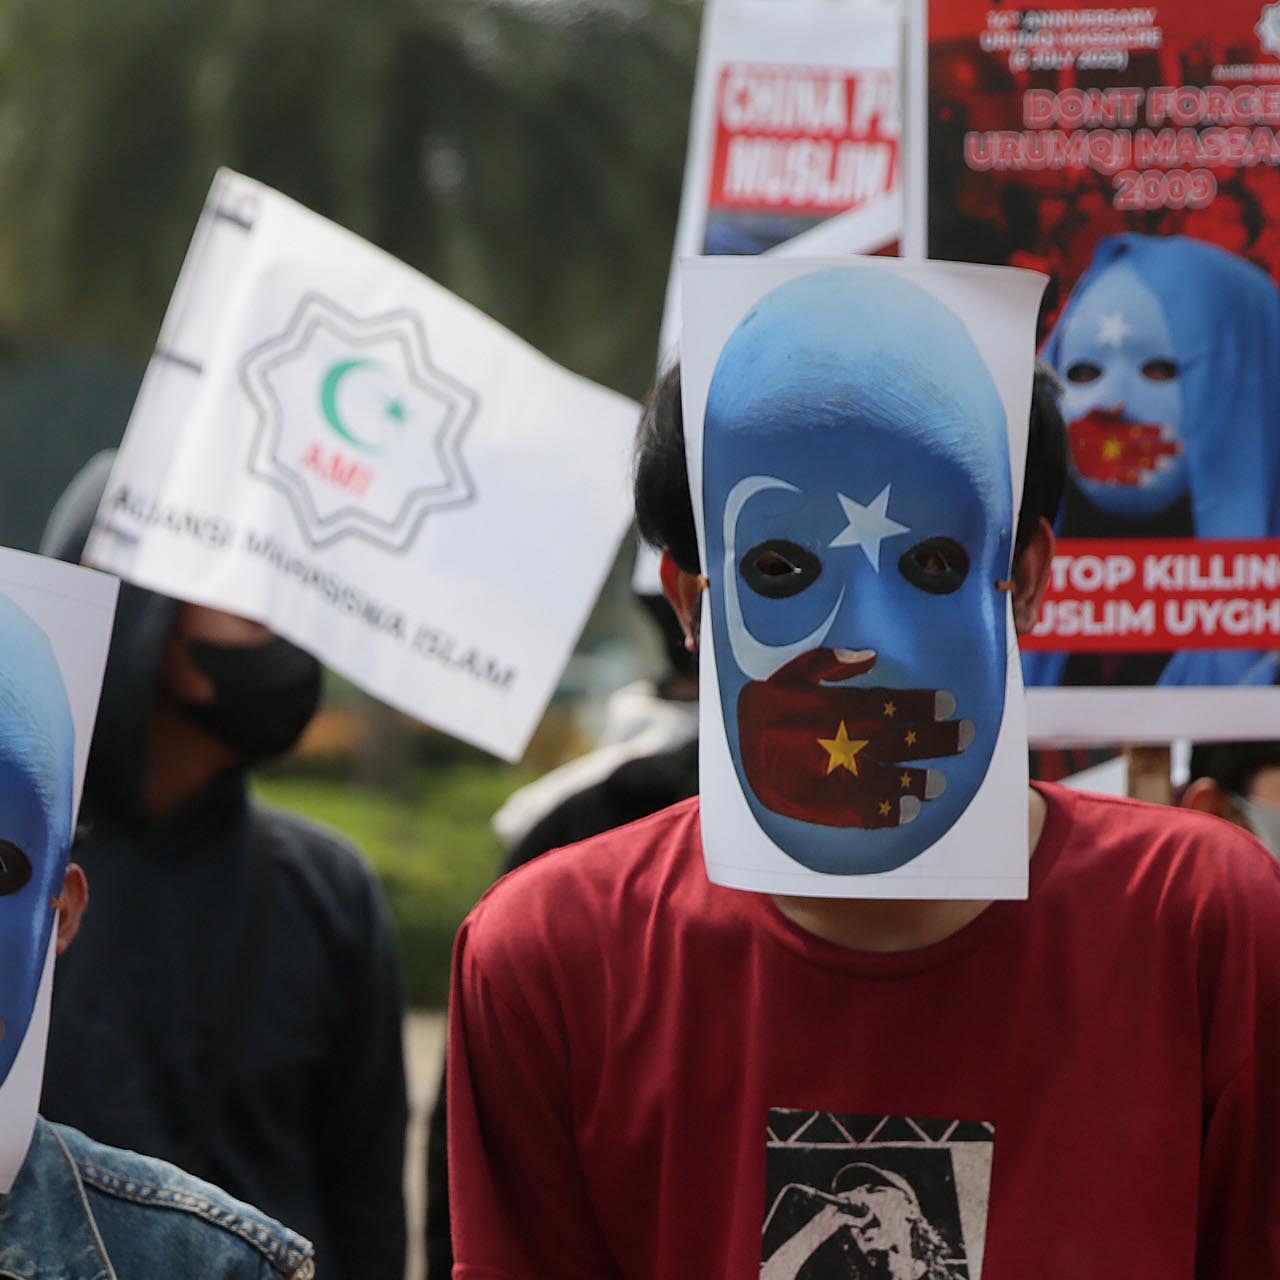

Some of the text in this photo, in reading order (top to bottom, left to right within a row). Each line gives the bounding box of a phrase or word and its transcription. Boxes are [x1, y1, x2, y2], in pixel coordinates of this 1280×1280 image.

[965, 130, 1133, 175] URUMQI
[1113, 169, 1217, 209] 2009
[1047, 554, 1136, 592] TOP
[1032, 598, 1156, 636] USLIM
[411, 620, 520, 691] ISLAM
